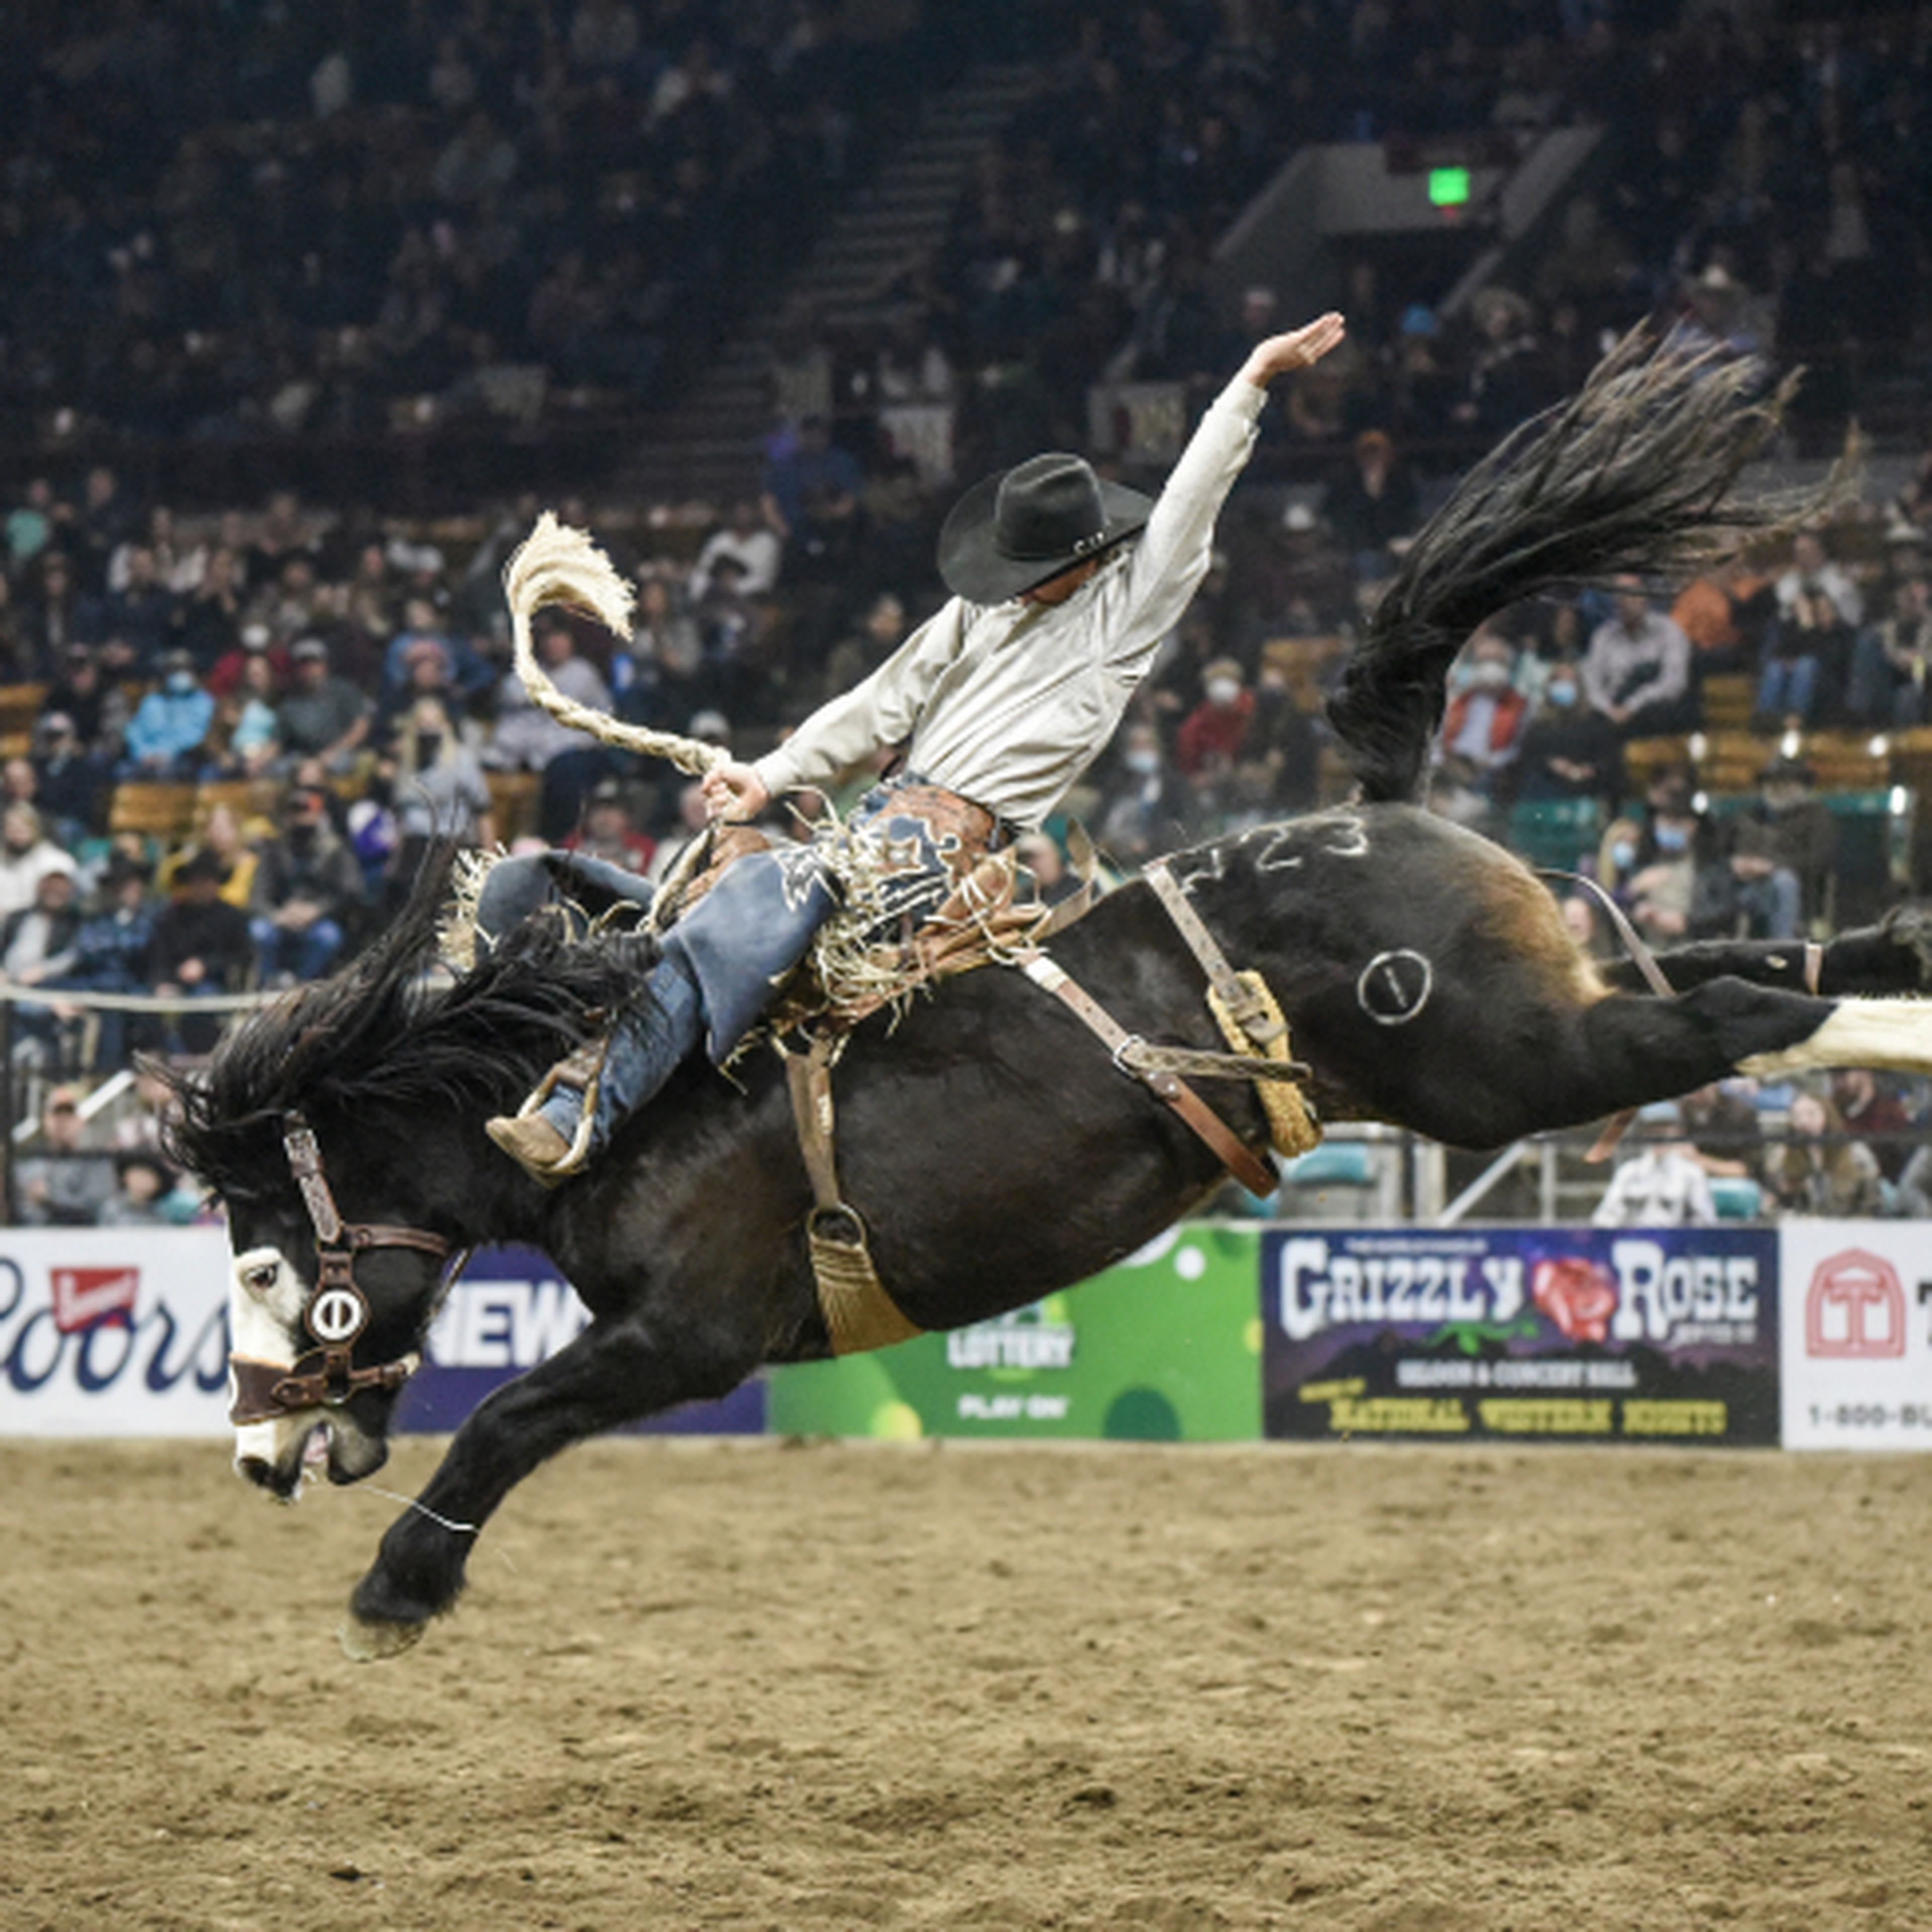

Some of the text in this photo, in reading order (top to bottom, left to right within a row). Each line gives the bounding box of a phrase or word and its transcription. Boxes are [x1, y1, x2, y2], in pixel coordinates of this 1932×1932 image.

[1280, 1237, 1759, 1340] GRIZZLY ROSE
[958, 1395, 1022, 1419] PLAY
